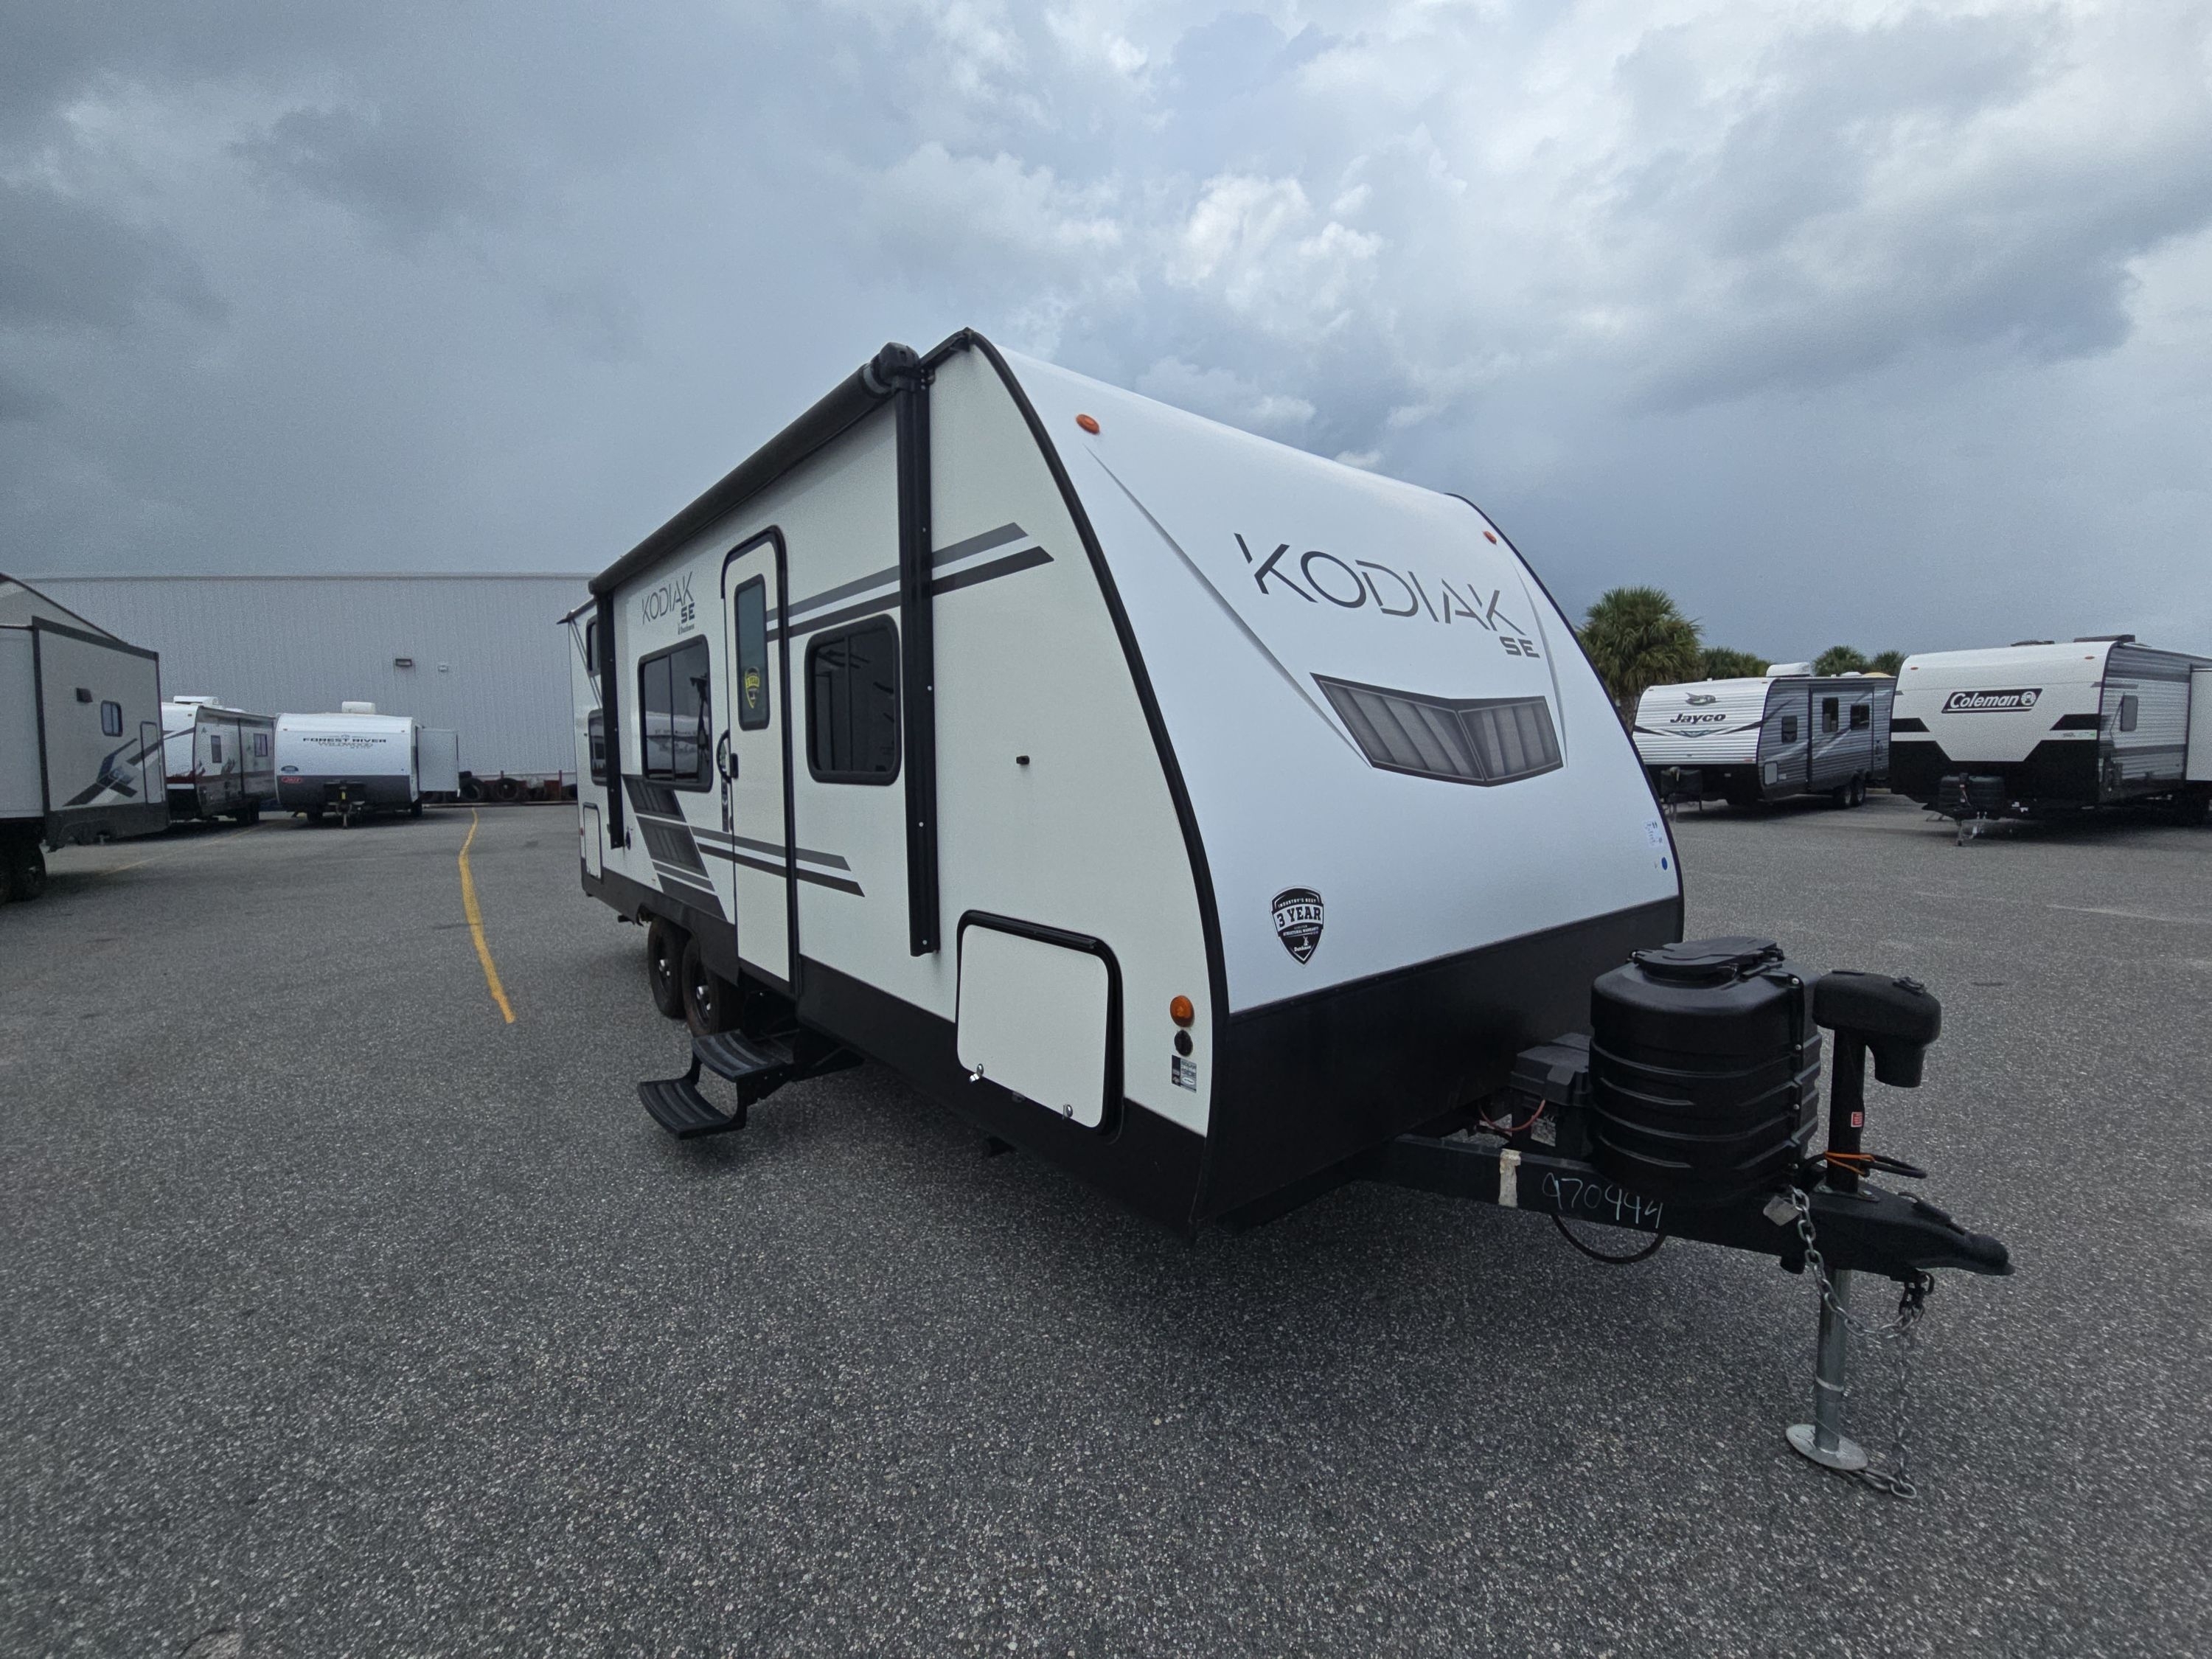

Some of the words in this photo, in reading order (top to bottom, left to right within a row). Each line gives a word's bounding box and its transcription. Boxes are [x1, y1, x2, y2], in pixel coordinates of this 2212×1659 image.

[1234, 532, 1526, 636] KODIAK
[642, 571, 694, 625] KODIAK
[681, 602, 695, 624] SE
[1499, 636, 1540, 658] SE
[1950, 692, 2020, 709] Coleman
[1670, 713, 1726, 724] Jayco
[1276, 913, 1285, 928] 3
[1287, 906, 1321, 922] YEAR
